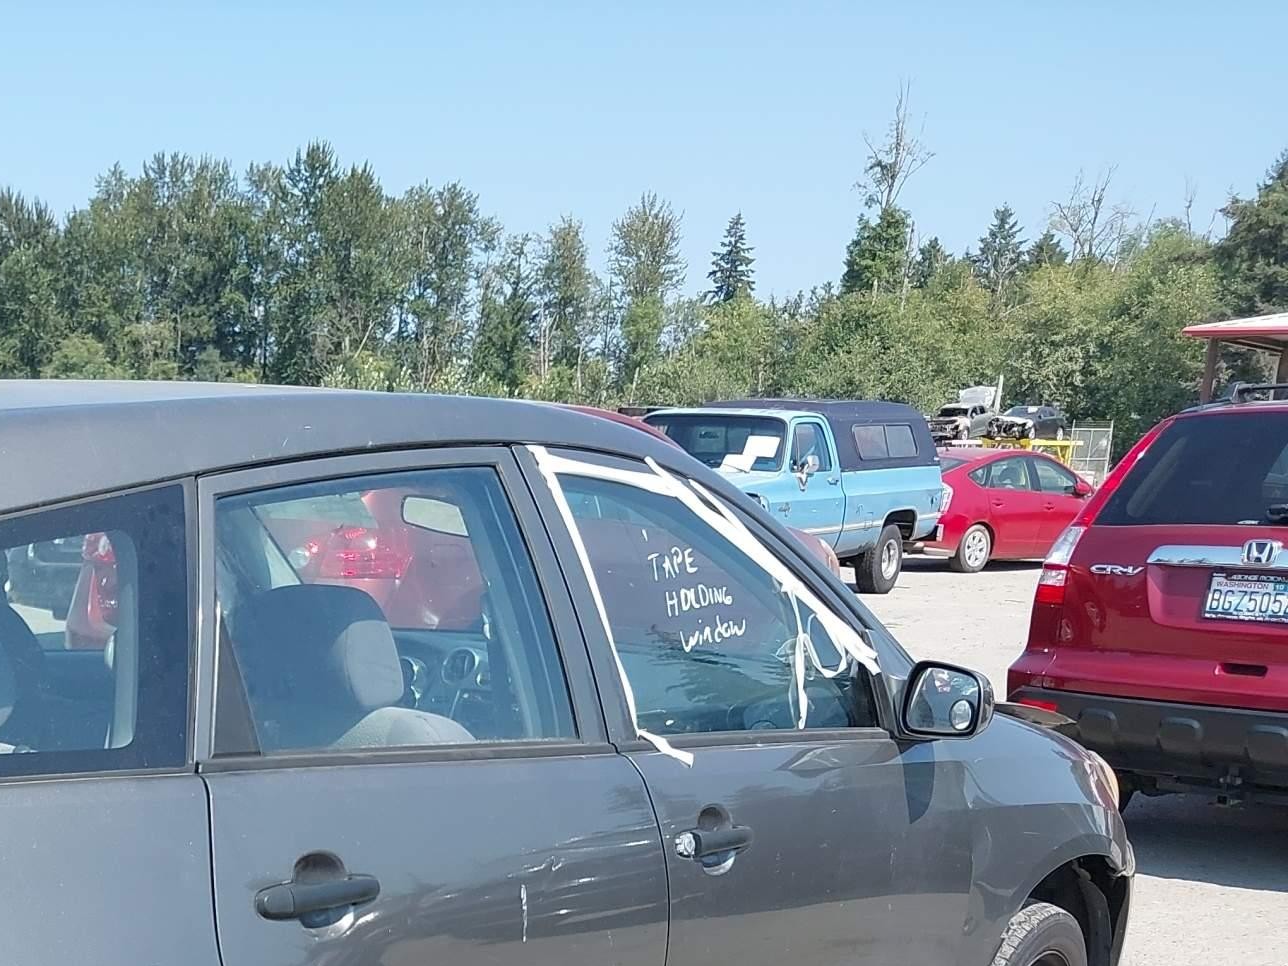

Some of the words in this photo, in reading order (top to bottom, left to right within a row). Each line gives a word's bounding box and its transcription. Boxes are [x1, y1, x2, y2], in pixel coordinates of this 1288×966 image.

[647, 546, 698, 581] TAPE
[1090, 564, 1145, 576] CR-V
[1216, 581, 1269, 590] WASHINGTON
[665, 584, 732, 617] HOLDING
[1209, 589, 1288, 615] BGZ505
